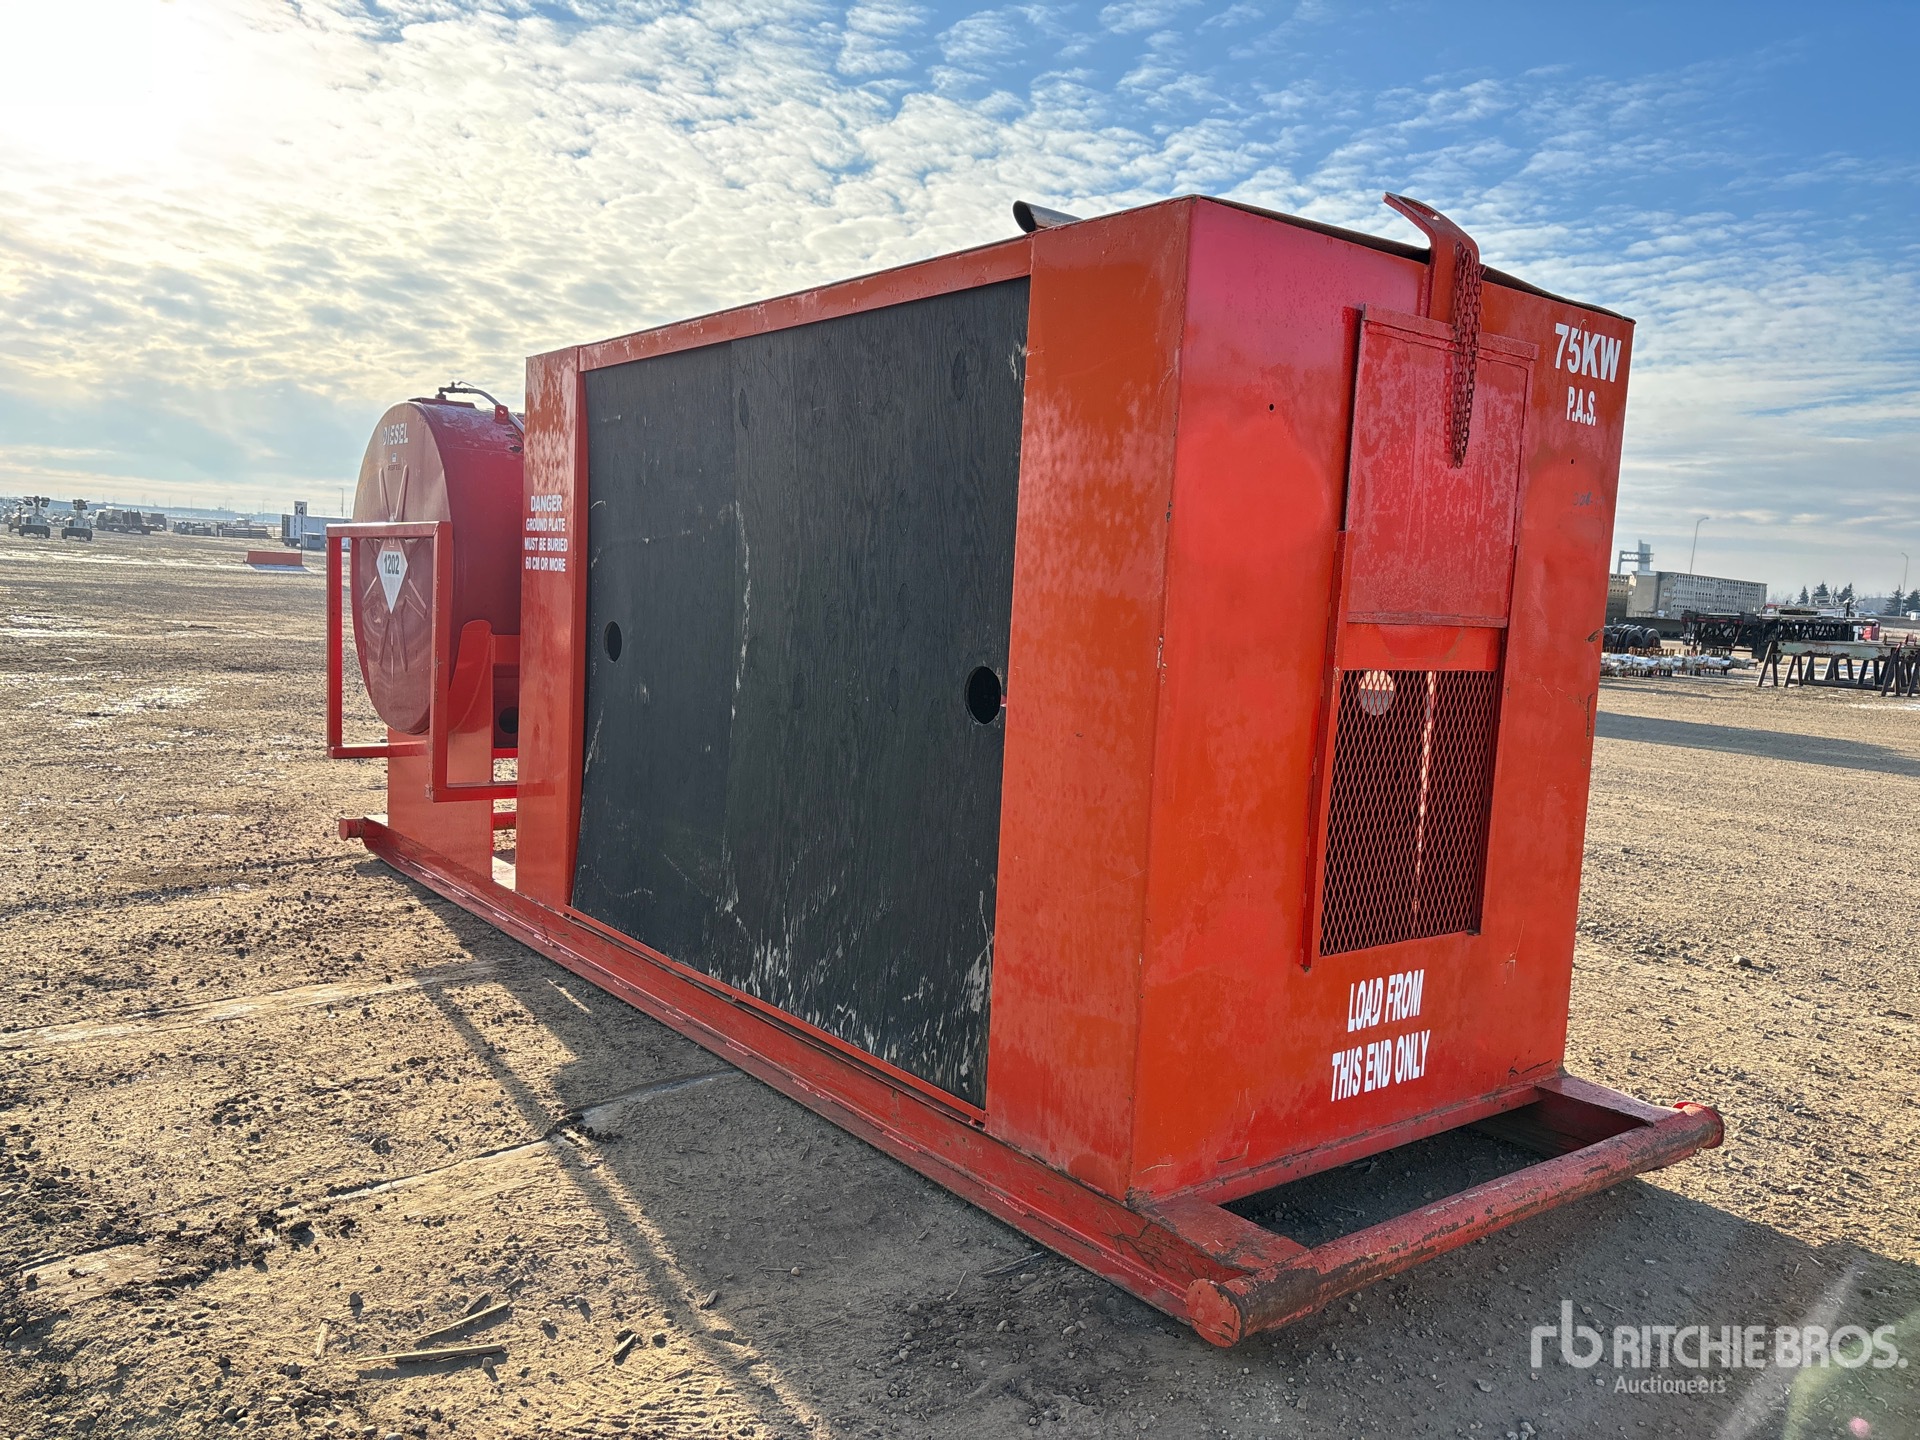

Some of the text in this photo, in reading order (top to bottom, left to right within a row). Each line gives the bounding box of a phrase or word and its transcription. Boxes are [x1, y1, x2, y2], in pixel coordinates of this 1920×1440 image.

[1555, 323, 1621, 382] 75KW
[1567, 386, 1596, 426] P.A.S.
[383, 423, 409, 446] DIESEL
[530, 495, 562, 512] DANGER
[526, 518, 566, 532] GROUND PLATE
[524, 537, 568, 552] MUST BE BURIED
[384, 554, 400, 575] 1202
[525, 556, 566, 572] 60 CM OR MORE
[1347, 969, 1425, 1032] LOAD FROM
[1331, 1029, 1431, 1102] THIS END ONLY
